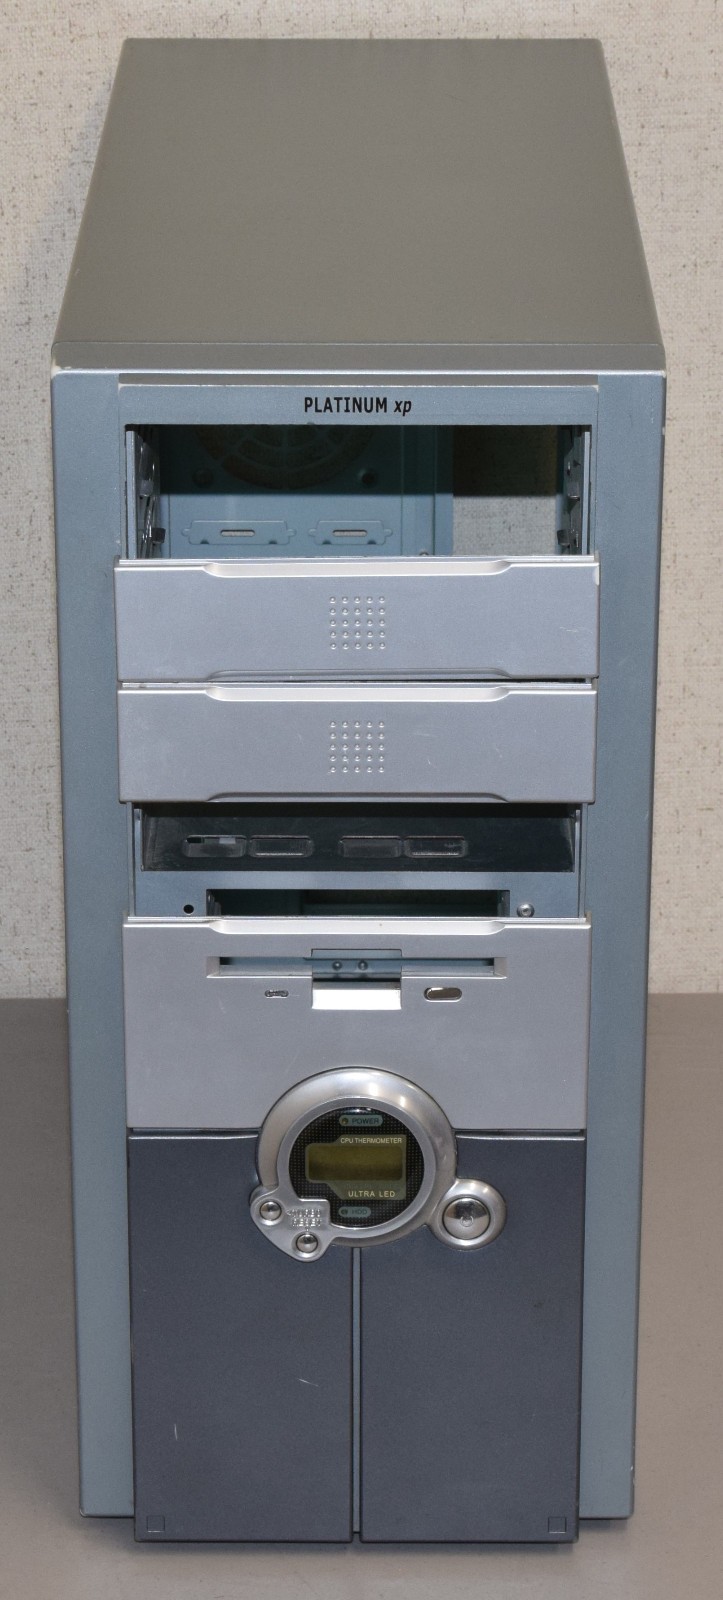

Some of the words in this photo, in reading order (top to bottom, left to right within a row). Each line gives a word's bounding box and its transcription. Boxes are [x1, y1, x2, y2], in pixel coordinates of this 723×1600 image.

[304, 396, 388, 413] PLATINUM
[393, 400, 412, 417] xp
[351, 1117, 379, 1125] POWER
[348, 1190, 375, 1198] ULTRA
[379, 1190, 396, 1198] LED
